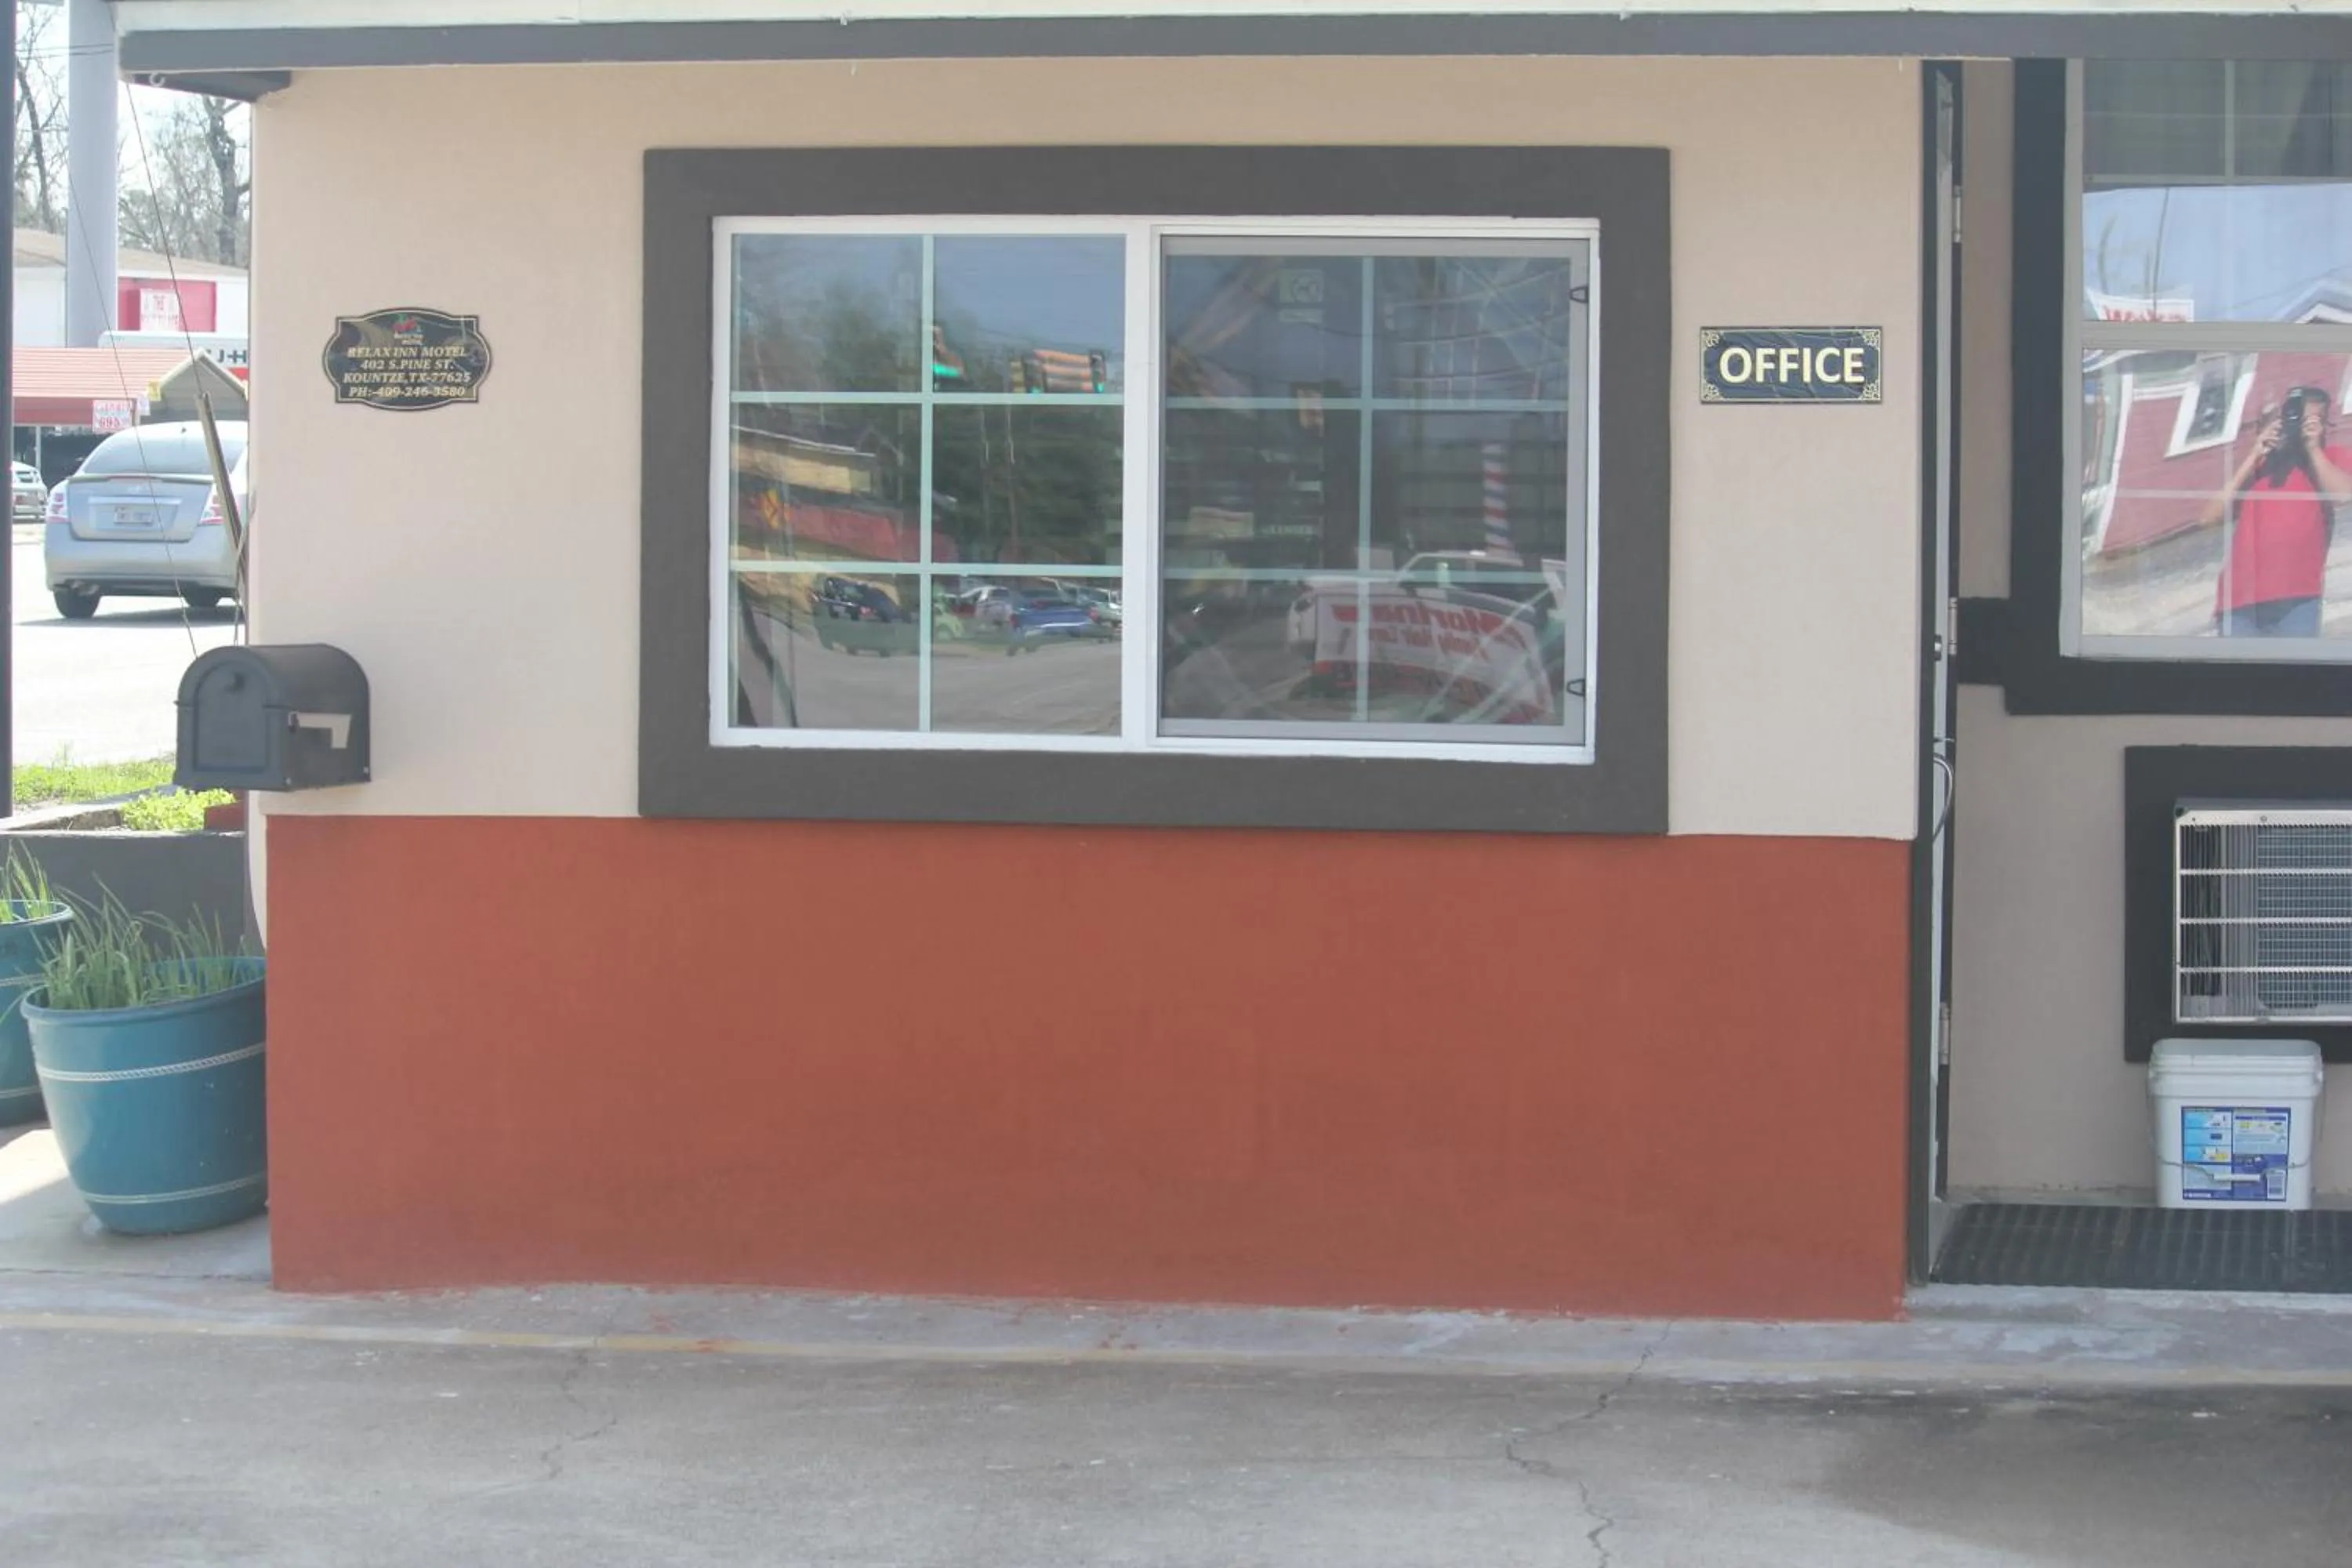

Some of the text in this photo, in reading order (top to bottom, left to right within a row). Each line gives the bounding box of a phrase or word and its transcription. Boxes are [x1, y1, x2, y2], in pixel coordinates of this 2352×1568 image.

[347, 346, 466, 358] RELAX INN MOTEL
[360, 359, 384, 370] 402
[434, 359, 454, 370] ST.
[1719, 347, 1865, 383] OFFICE
